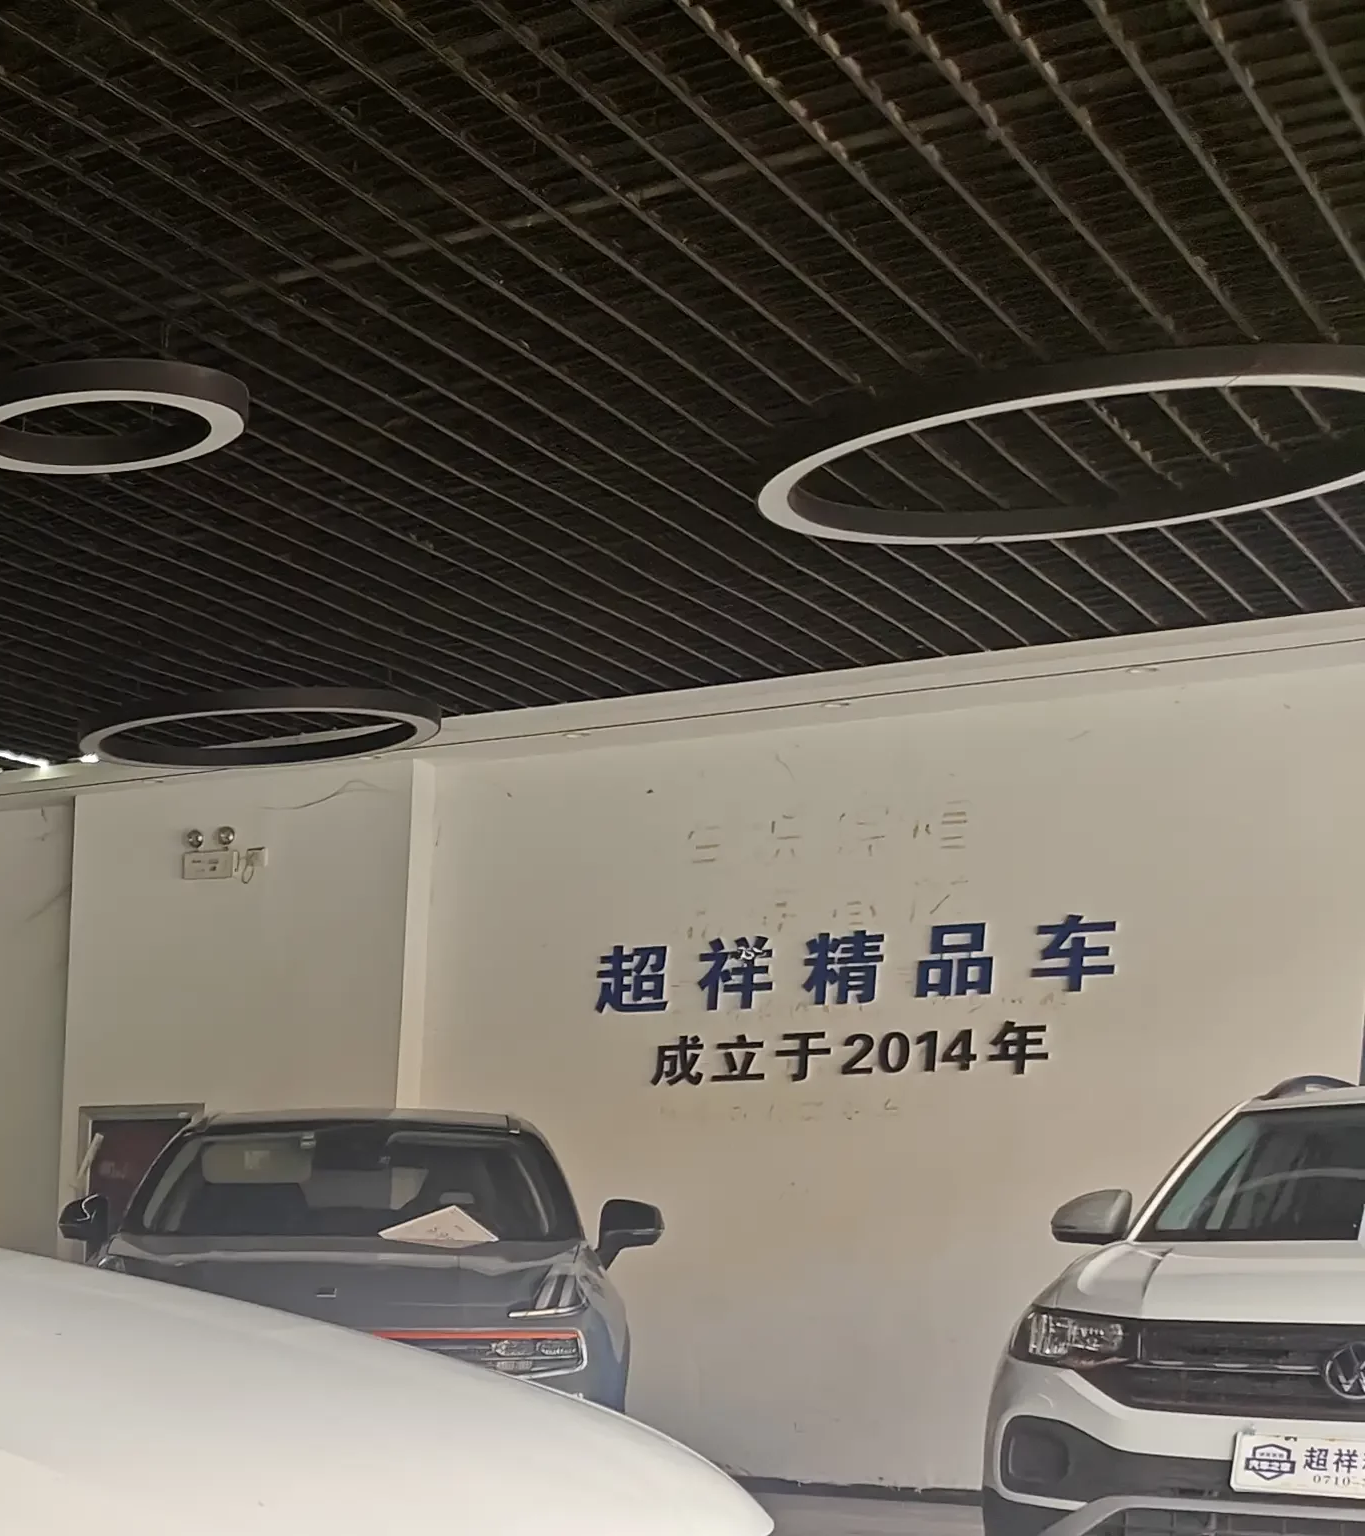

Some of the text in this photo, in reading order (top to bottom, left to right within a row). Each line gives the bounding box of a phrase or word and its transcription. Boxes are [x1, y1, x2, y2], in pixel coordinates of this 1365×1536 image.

[594, 914, 1117, 1014] 超祥精品车
[650, 1020, 1049, 1087] 成立于2014年
[1303, 1447, 1365, 1474] 超祥
